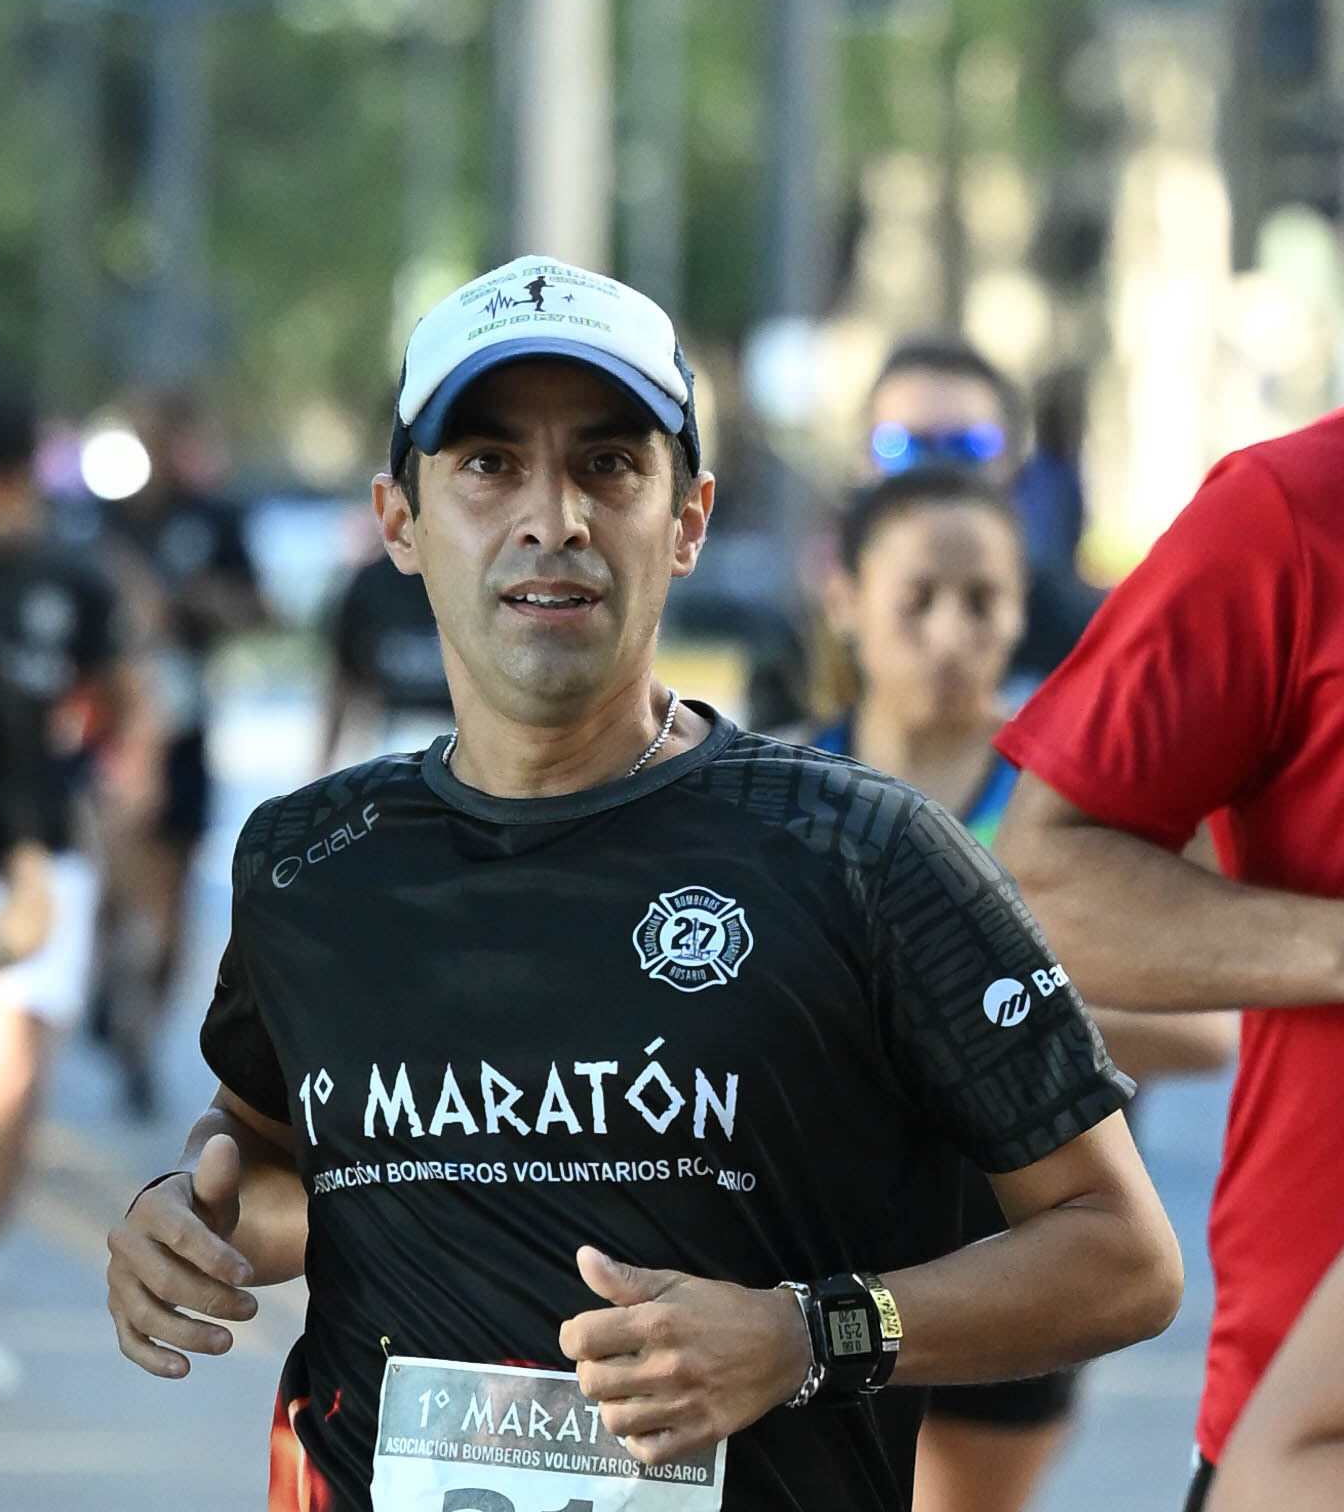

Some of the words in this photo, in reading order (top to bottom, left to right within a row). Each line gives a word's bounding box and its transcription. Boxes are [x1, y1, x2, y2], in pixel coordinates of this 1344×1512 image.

[674, 894, 720, 911] BOMBEROS
[671, 916, 717, 951] 27
[669, 965, 707, 981] ROSARIO
[363, 1035, 739, 1142] MARATÓN
[387, 1159, 507, 1185] BOMBEROS
[513, 1160, 671, 1184] VOLUNTARIOS
[461, 1391, 618, 1446] MARAT
[385, 1436, 458, 1459] ASOCIACIÓN
[462, 1445, 541, 1467] BOMBEROS
[545, 1451, 641, 1477] VOLUNTARIOS
[644, 1462, 708, 1483] ROSARIO
